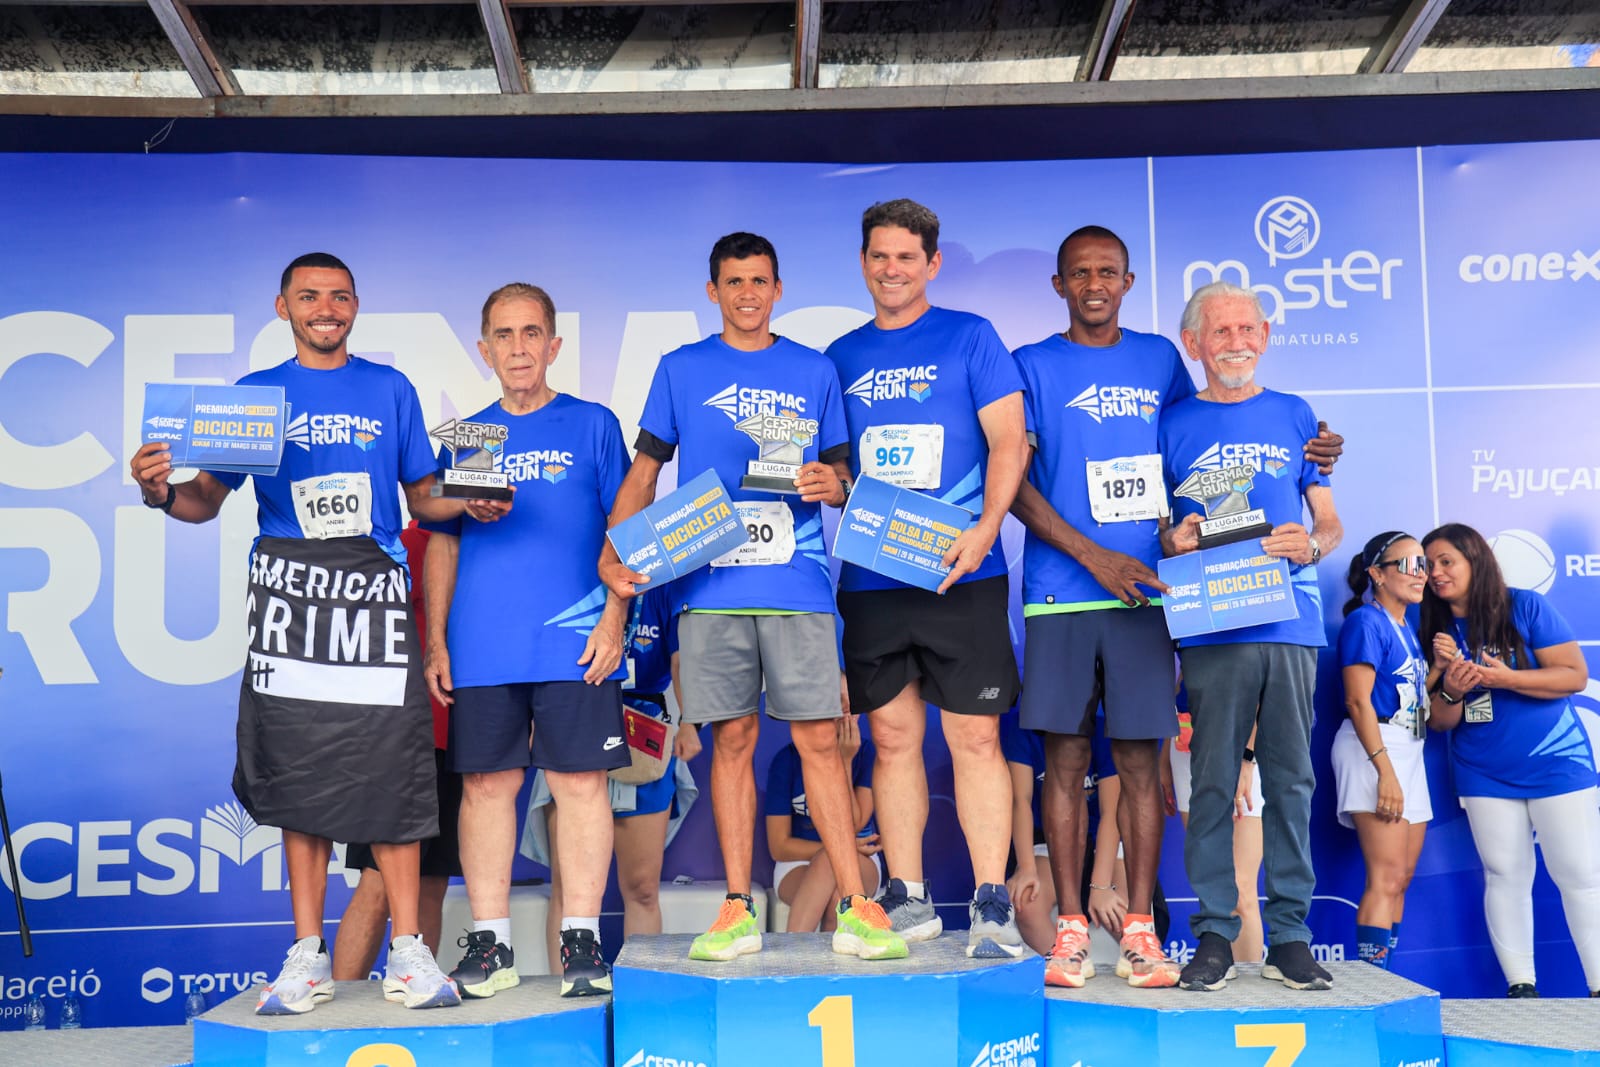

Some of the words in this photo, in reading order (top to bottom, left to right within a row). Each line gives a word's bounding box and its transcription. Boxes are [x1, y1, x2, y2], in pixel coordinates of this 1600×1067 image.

[874, 365, 938, 386] CESMAC
[738, 387, 806, 412] CESMAC
[873, 382, 907, 401] RUN
[1099, 386, 1160, 406] CESMAC
[195, 404, 244, 416] PREMIAÇÃO
[738, 401, 776, 418] RUN
[1101, 401, 1139, 418] RUN
[193, 420, 274, 438] BICICLETA
[310, 414, 382, 436] CESMAC
[456, 423, 507, 440] CESMAC
[763, 417, 817, 432] CESMAC
[311, 427, 350, 445] RUN
[455, 434, 482, 448] RUN
[762, 429, 791, 441] RUN
[504, 450, 573, 466] CESMAC
[875, 446, 915, 467] 967
[1221, 442, 1291, 462] CESMAC
[1472, 449, 1495, 462] TV
[460, 473, 487, 481] LUGAR
[504, 462, 539, 483] RUN
[762, 464, 791, 473] LUGAR
[1200, 465, 1255, 486] CESMAC
[1102, 477, 1146, 499] 1879
[1202, 481, 1231, 497] RUN
[307, 494, 359, 519] 1660
[655, 503, 696, 532] PREMIAÇÃO
[662, 502, 732, 551] BICICLETA
[894, 508, 932, 528] PREMIAÇÃO
[1214, 516, 1244, 528] LUGAR
[1245, 513, 1261, 523] 10K
[890, 520, 921, 539] BOLSA
[922, 530, 936, 544] DE
[1204, 558, 1250, 575] PREMIAÇÃO
[250, 552, 407, 603] AMERICAN
[1207, 569, 1283, 597] BICICLETA
[247, 590, 409, 664] CRIME
[990, 1032, 1040, 1063] CESMAC
